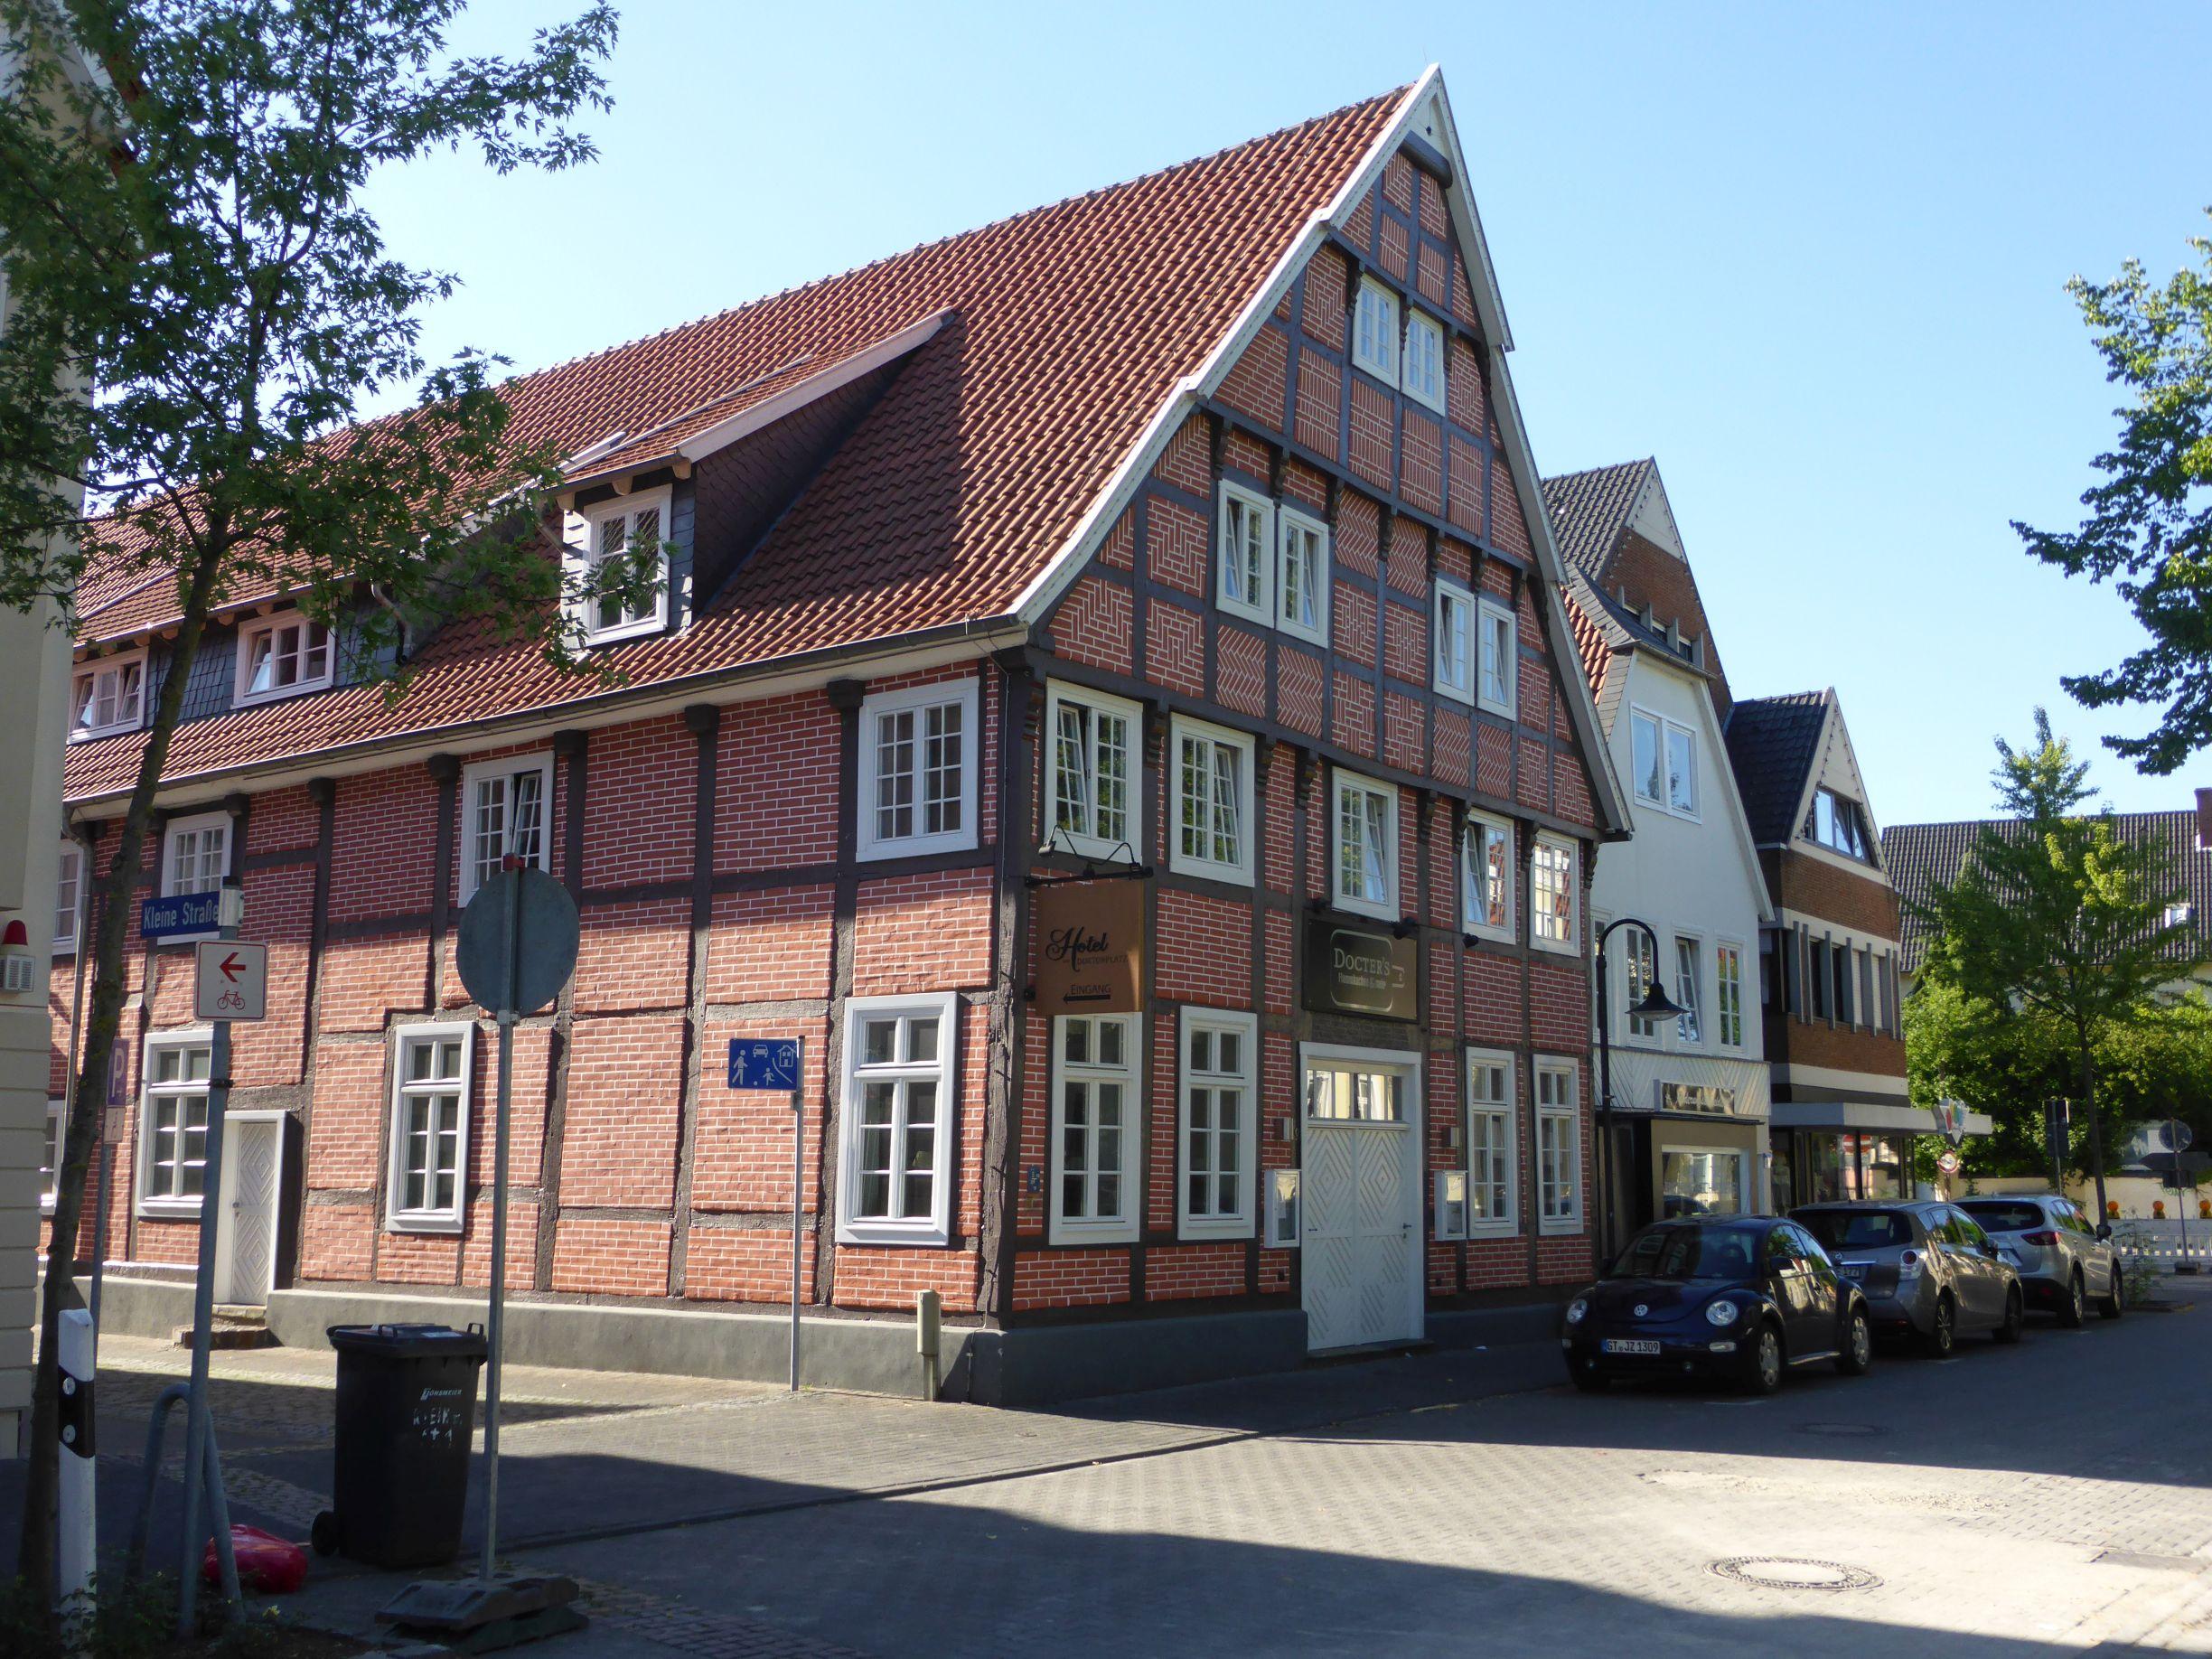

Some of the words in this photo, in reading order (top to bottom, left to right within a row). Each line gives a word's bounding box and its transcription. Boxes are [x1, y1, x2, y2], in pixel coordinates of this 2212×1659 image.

[144, 904, 177, 930] Kleine
[182, 899, 219, 925] Straße
[1045, 926, 1110, 972] Hotel
[1071, 983, 1111, 995] EINGANG
[111, 1048, 125, 1098] P
[1607, 1340, 1617, 1351] GT
[1624, 1341, 1636, 1352] JZ
[1636, 1342, 1659, 1353] 1309
